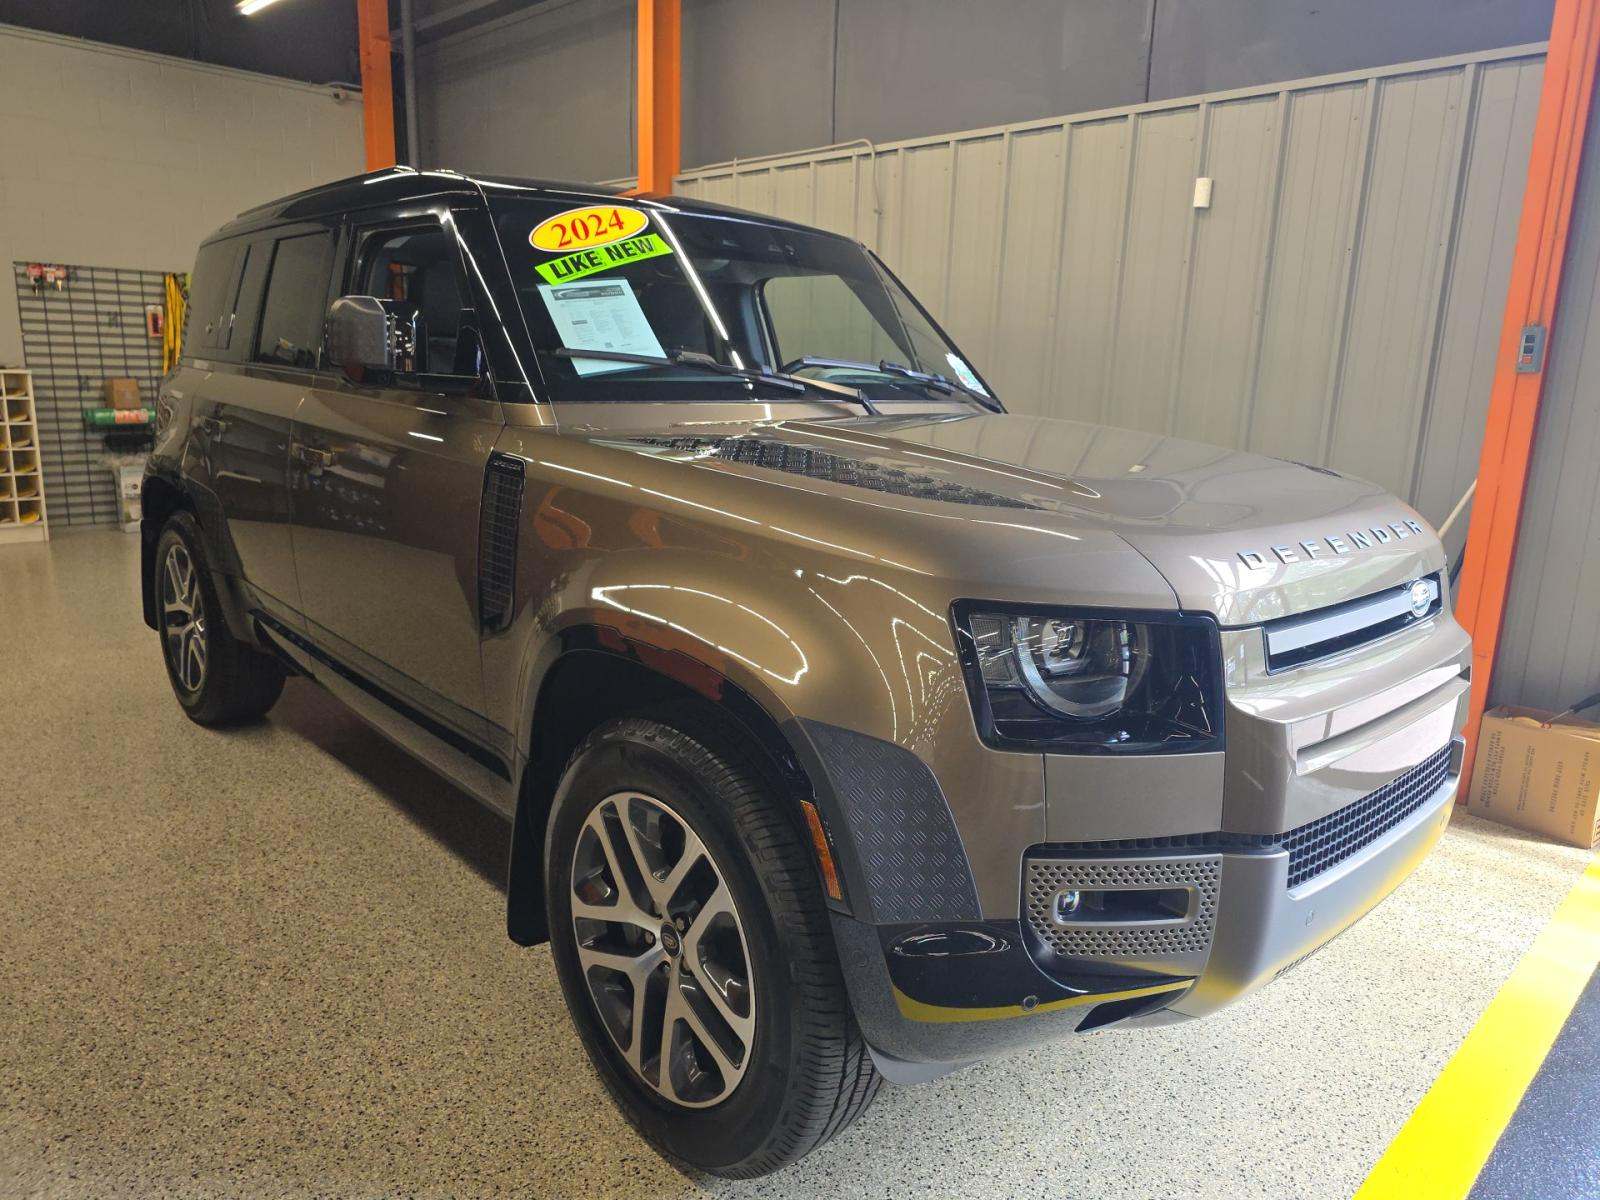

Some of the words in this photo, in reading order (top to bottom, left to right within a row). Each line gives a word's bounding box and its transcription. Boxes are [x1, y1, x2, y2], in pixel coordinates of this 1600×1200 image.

[551, 209, 624, 248] 2024
[549, 251, 602, 278] LIKE
[604, 238, 654, 261] NEW
[1237, 520, 1423, 570] DEFENDER
